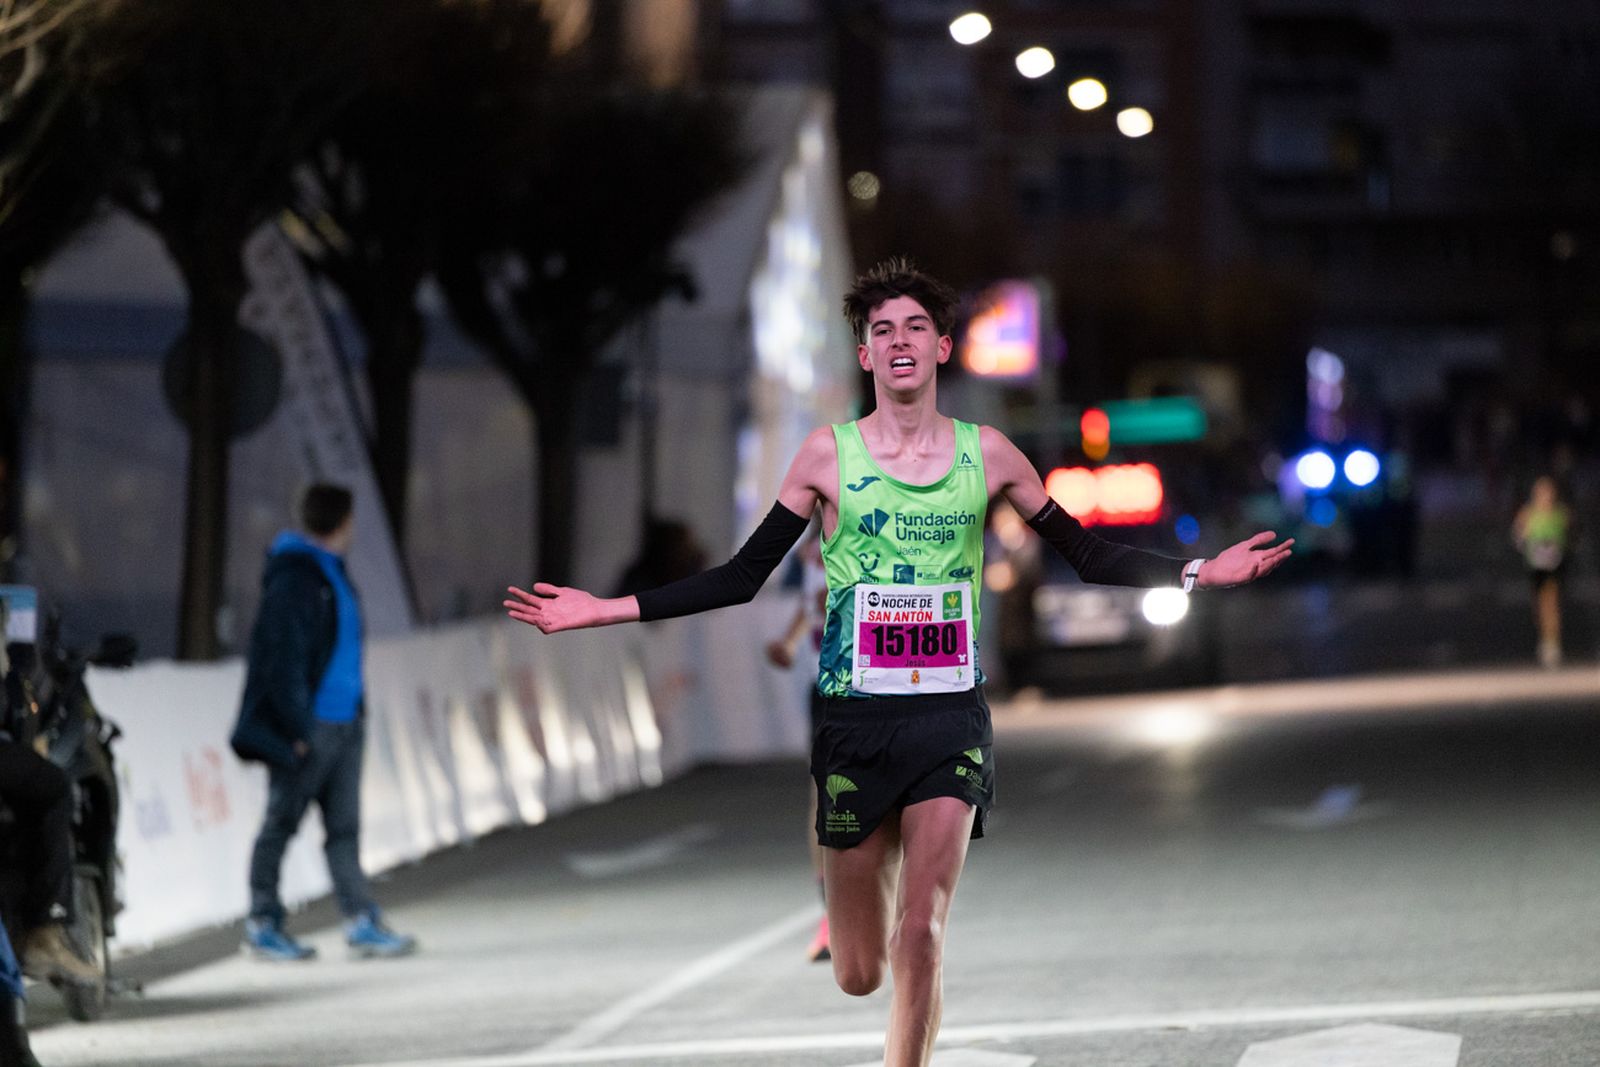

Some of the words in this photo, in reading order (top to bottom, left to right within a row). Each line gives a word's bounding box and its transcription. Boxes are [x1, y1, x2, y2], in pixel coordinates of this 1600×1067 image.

[895, 511, 976, 526] Fundación
[896, 527, 955, 544] Unicaja
[896, 546, 922, 556] Jaén
[881, 598, 917, 608] NOCHE
[919, 598, 933, 608] DE
[867, 610, 891, 622] SAN
[893, 608, 933, 622] ANTÓN
[871, 623, 957, 657] 15180
